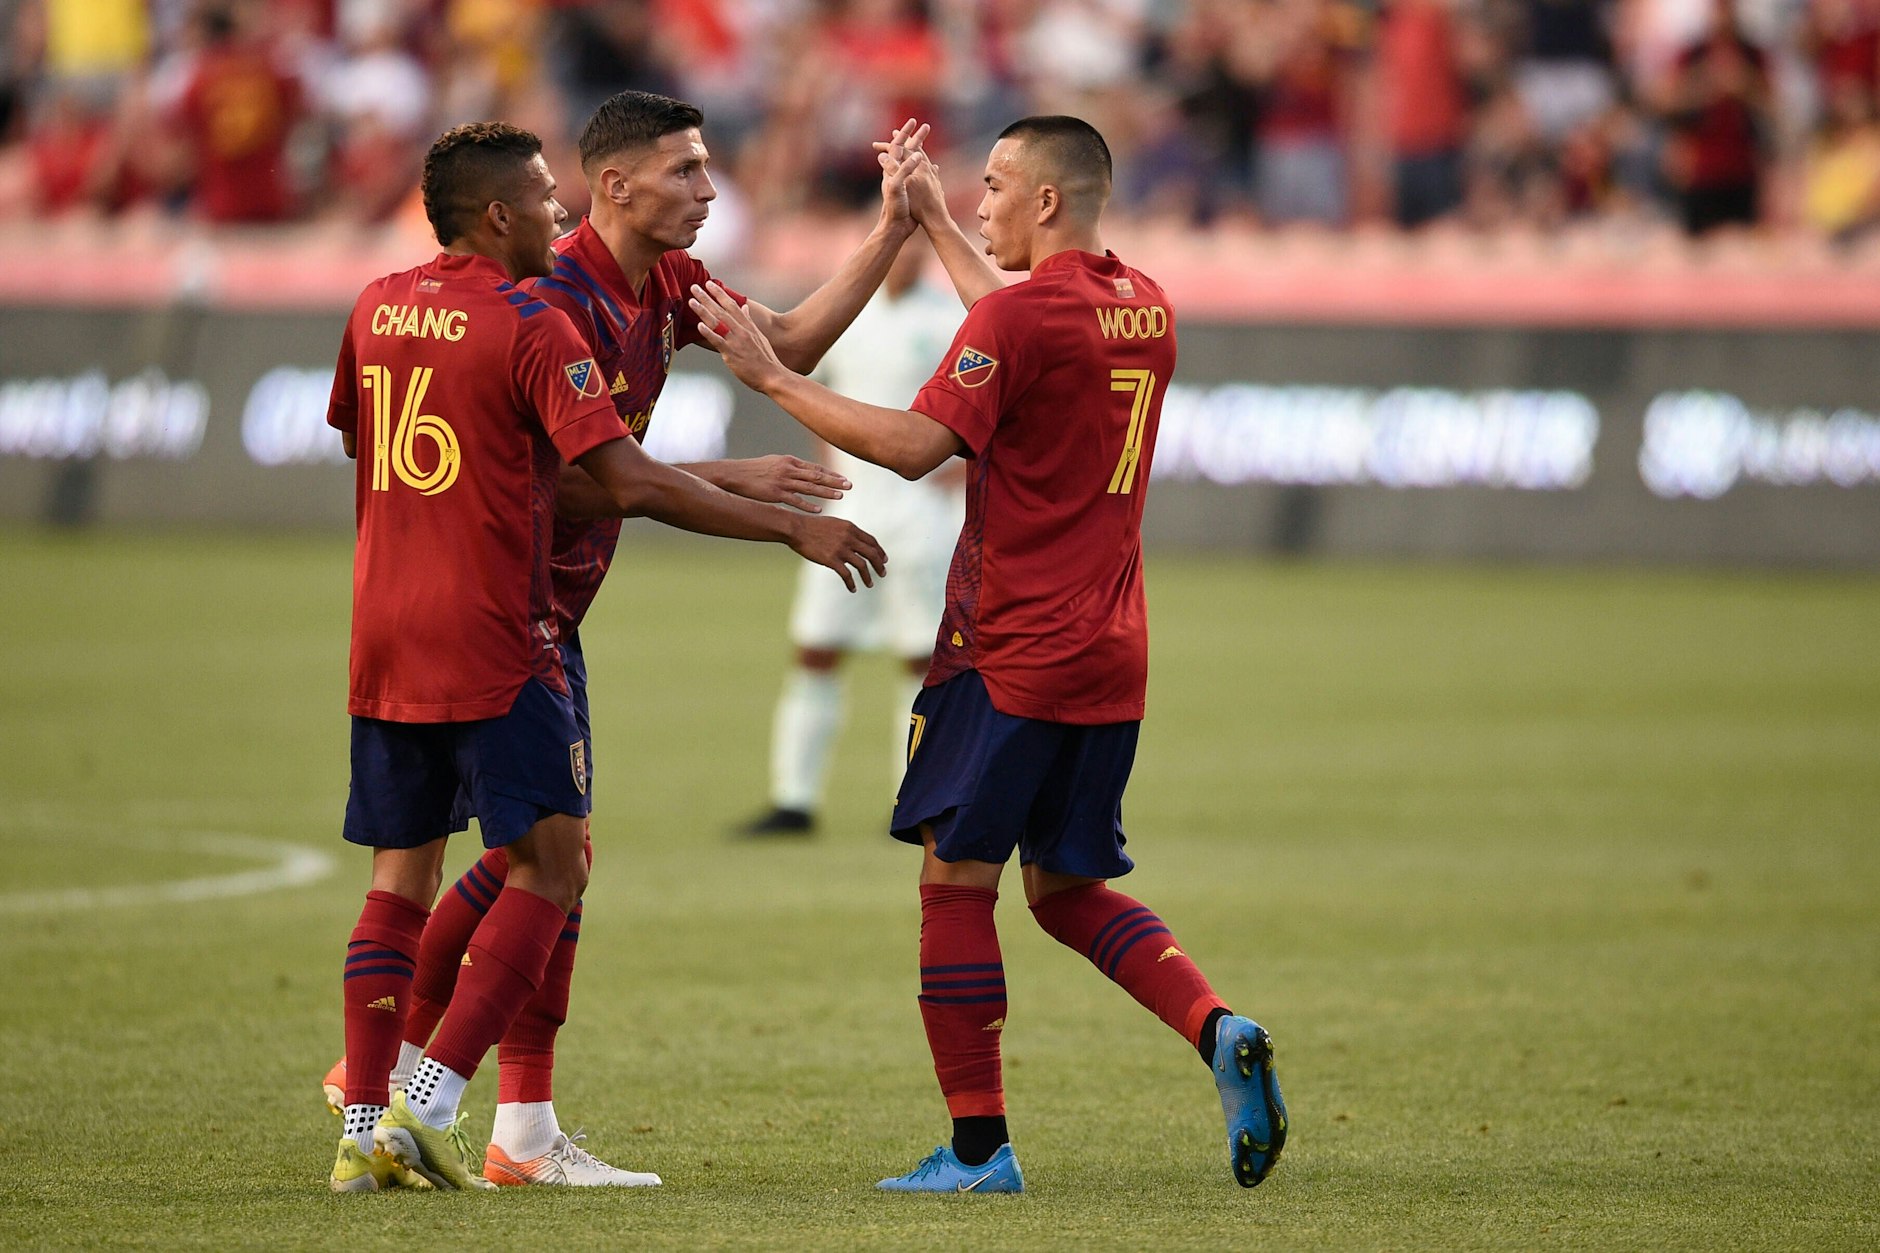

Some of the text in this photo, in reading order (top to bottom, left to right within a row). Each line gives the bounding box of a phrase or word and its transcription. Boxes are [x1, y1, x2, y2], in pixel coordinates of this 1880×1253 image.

[371, 304, 468, 342] CHANG
[1096, 306, 1167, 340] WOOD
[568, 363, 587, 376] MLS
[963, 351, 983, 364] MLS
[362, 365, 461, 496] 16
[1106, 369, 1156, 494] 7
[910, 713, 926, 764] 7
